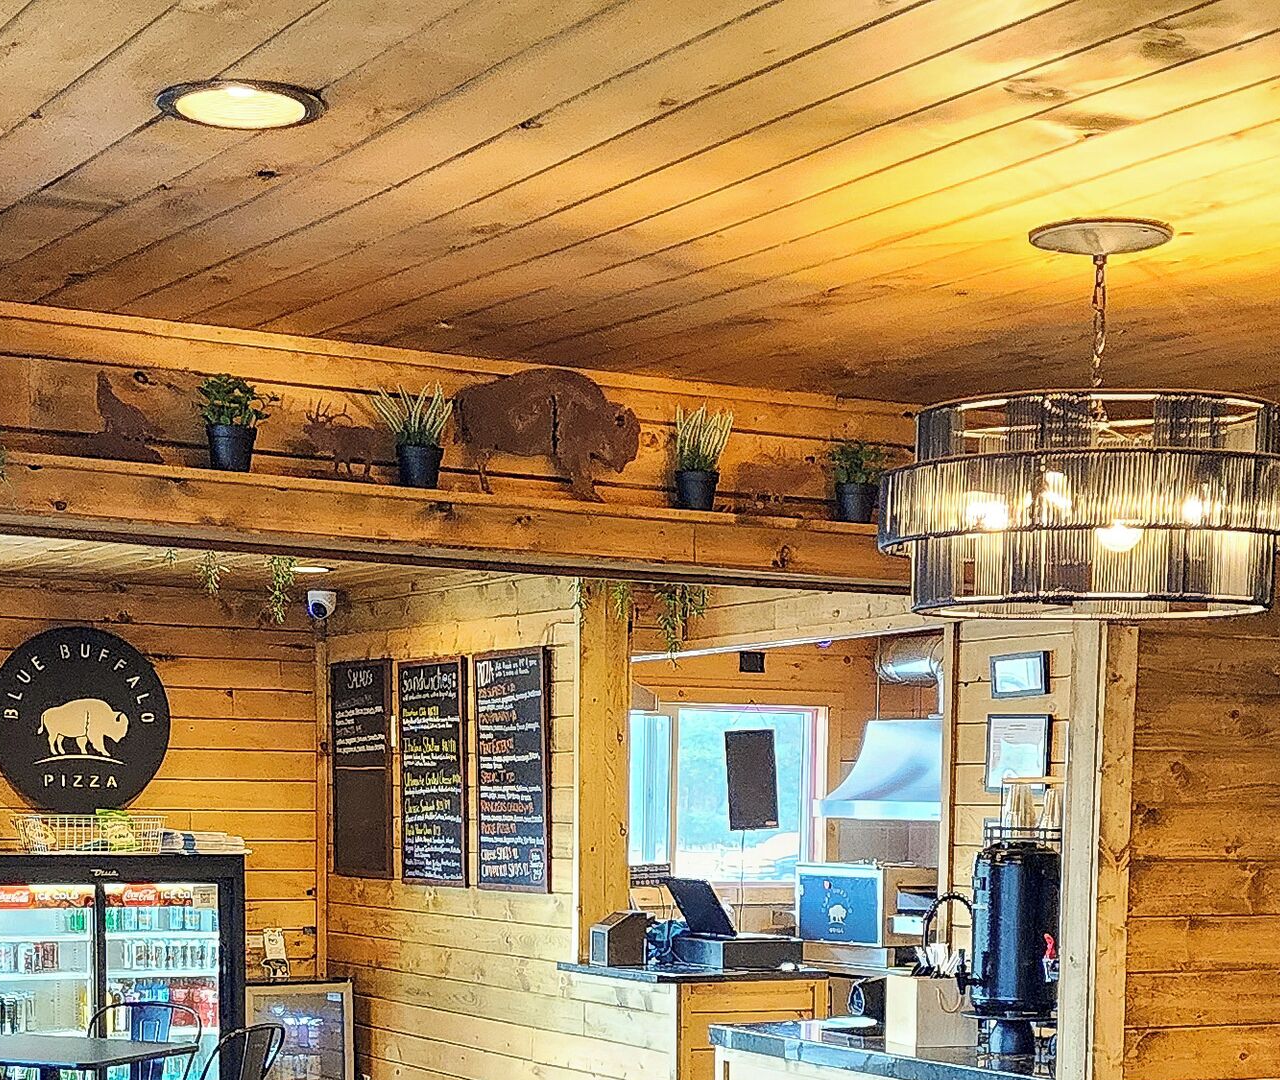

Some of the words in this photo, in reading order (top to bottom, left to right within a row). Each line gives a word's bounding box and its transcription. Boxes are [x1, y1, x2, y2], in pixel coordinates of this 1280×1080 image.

[4, 656, 45, 719] BLUE
[60, 644, 155, 724] BUFFALO
[44, 774, 118, 788] PIZZA
[52, 892, 80, 900] COLD
[124, 889, 157, 901] Coca-Cola
[161, 891, 174, 899] ICE
